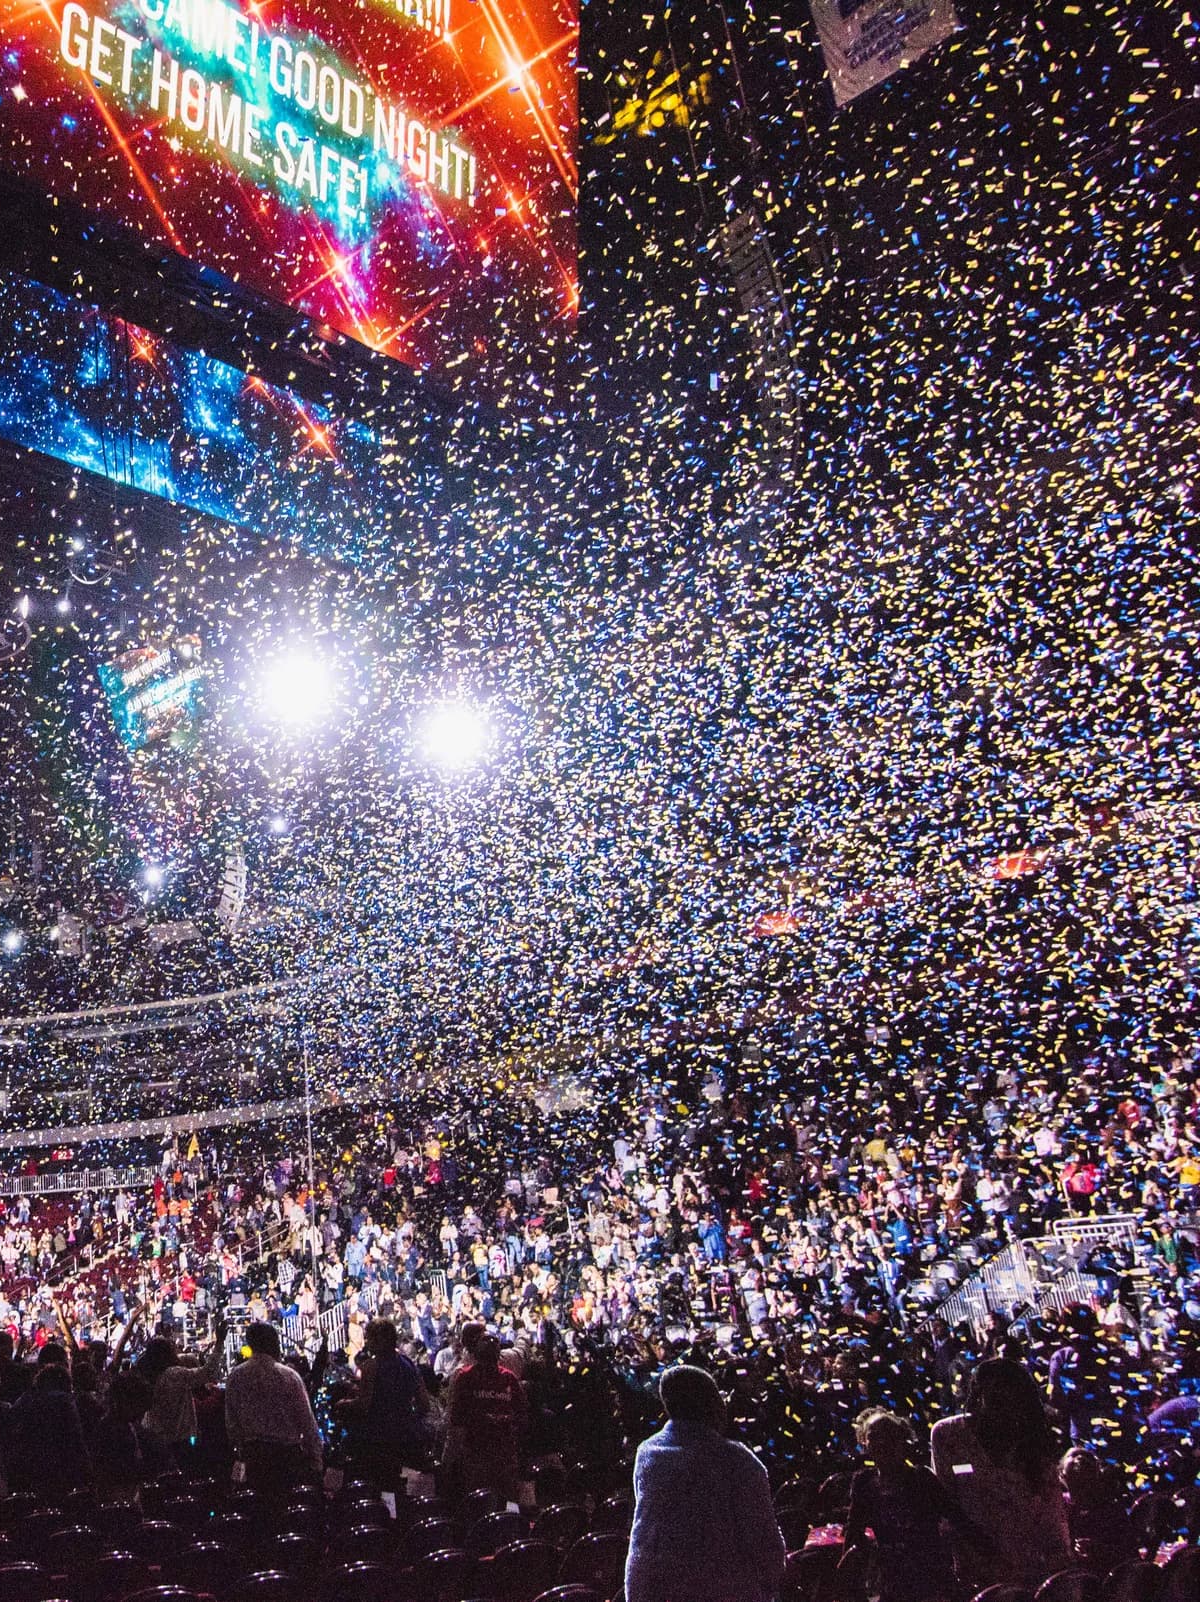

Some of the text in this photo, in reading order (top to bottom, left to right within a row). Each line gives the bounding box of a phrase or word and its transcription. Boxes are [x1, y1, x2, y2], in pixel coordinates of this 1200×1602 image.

[60, 2, 369, 223] GET HOME SAFE!
[269, 36, 364, 138] GOOD
[373, 97, 477, 207] NIGHT!
